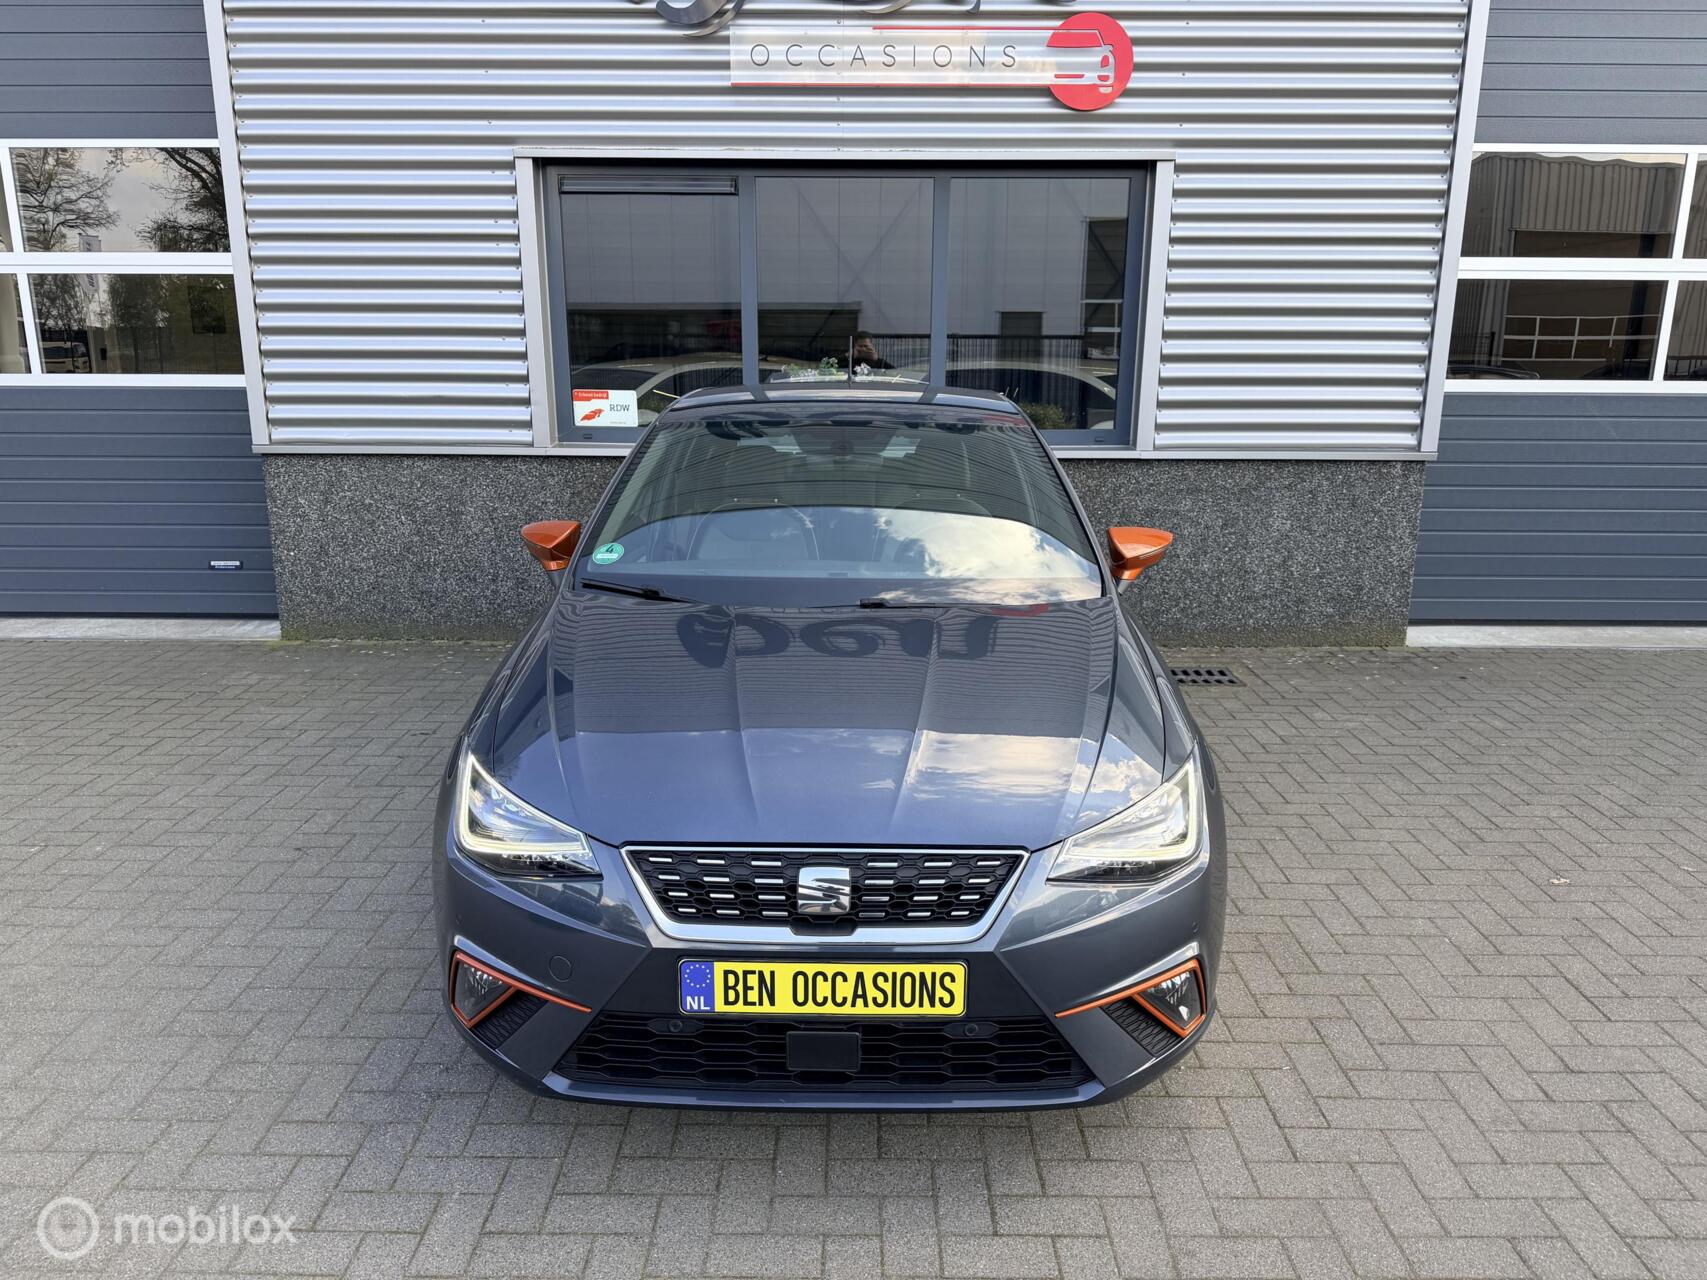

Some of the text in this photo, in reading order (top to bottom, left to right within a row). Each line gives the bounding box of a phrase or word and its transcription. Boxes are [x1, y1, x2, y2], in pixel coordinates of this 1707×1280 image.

[749, 43, 1018, 69] OCCASIONS
[609, 403, 630, 412] RDW
[605, 544, 614, 553] 4
[722, 969, 957, 1009] BEN OCCASIONS
[686, 996, 711, 1011] NL
